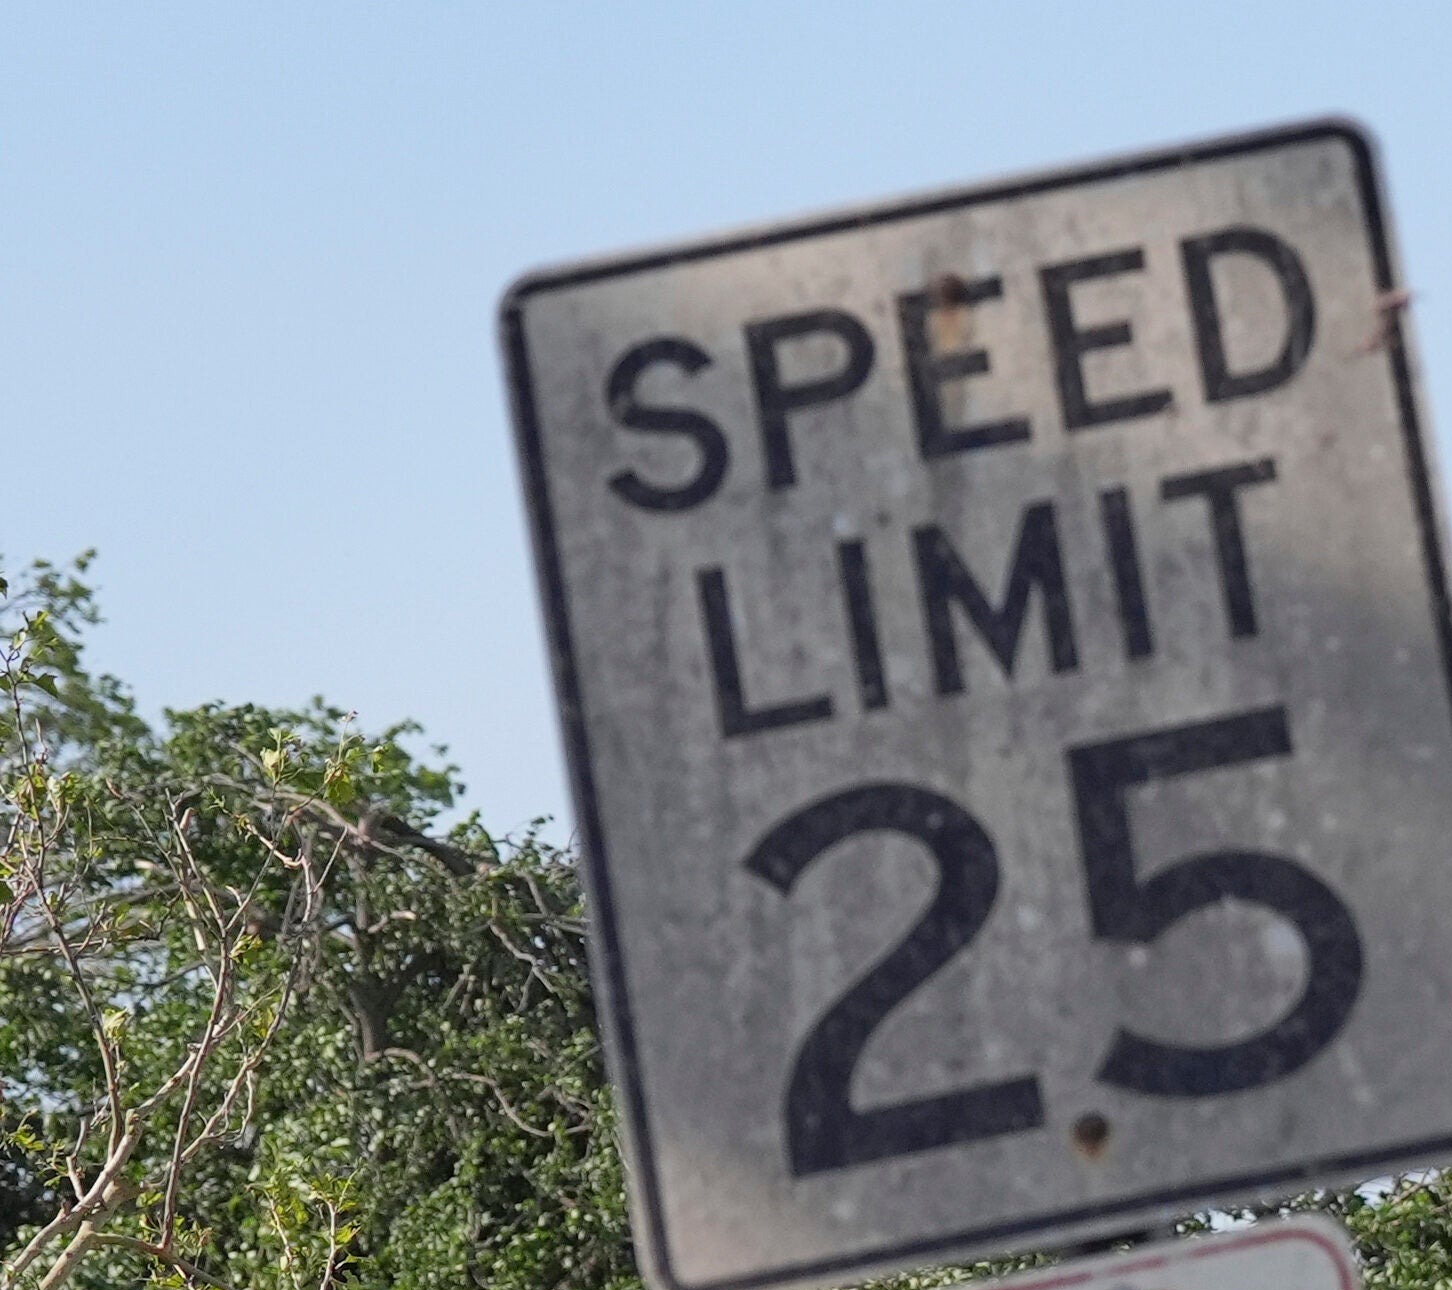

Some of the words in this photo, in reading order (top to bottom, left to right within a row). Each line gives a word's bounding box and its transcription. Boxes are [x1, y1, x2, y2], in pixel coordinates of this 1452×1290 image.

[604, 224, 1319, 514] SPEED
[694, 457, 1278, 742] LIMIT
[741, 703, 1367, 1178] 25
